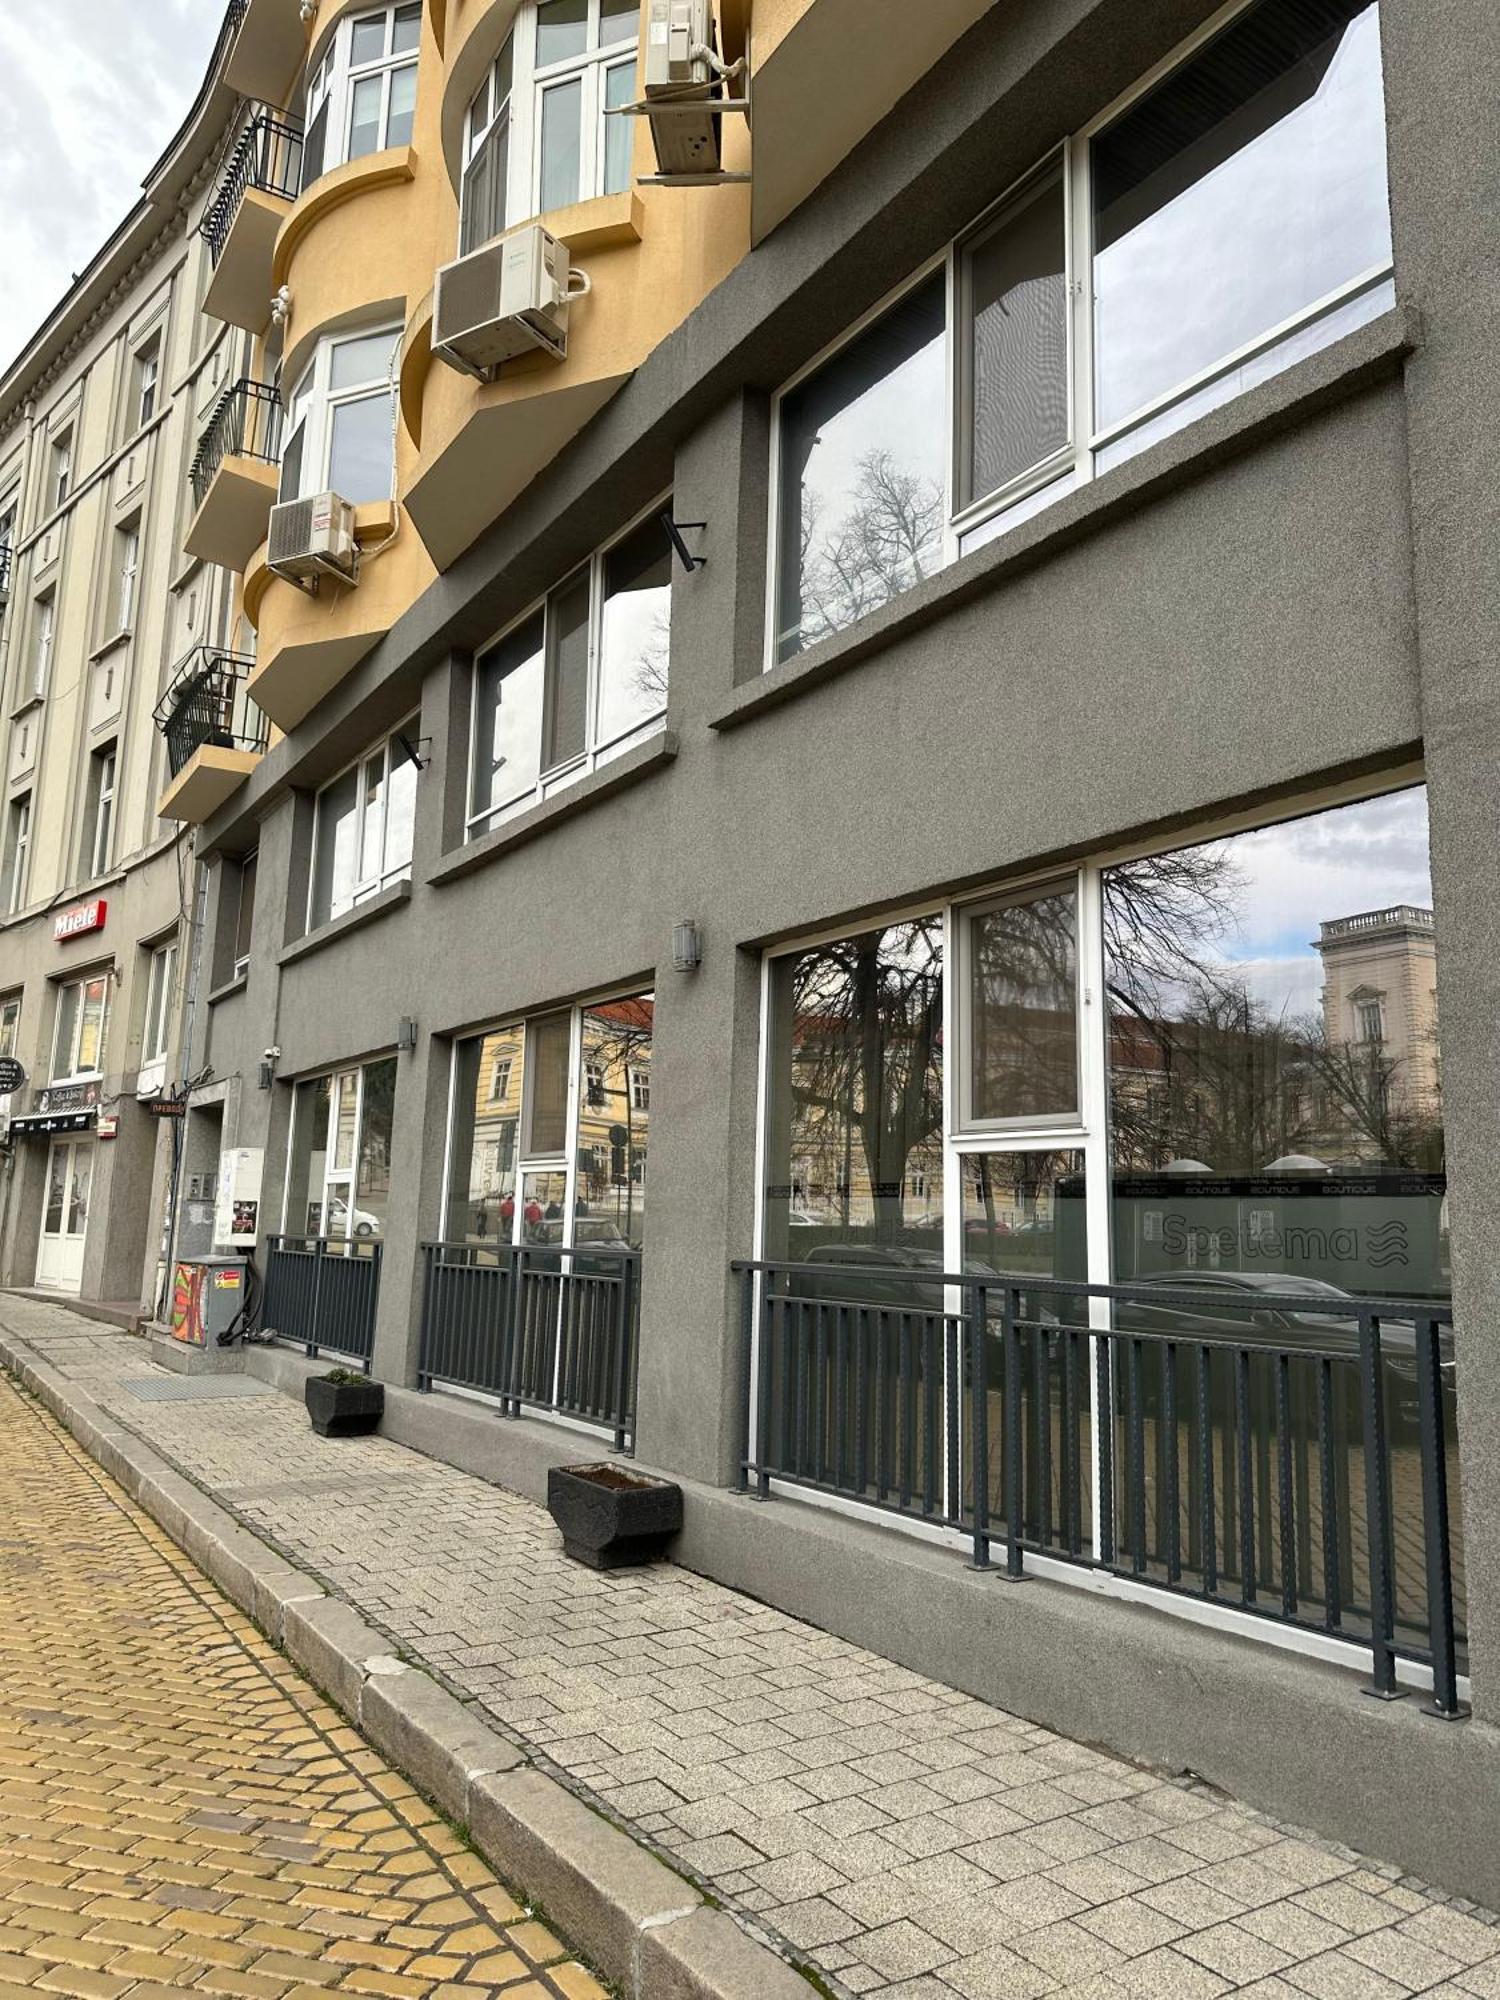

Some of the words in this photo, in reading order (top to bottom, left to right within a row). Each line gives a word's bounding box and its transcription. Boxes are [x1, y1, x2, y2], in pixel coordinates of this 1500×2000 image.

[54, 907, 96, 937] Miele
[1322, 1185, 1377, 1195] BOUTIQUE
[1162, 1213, 1359, 1265] Spetema
